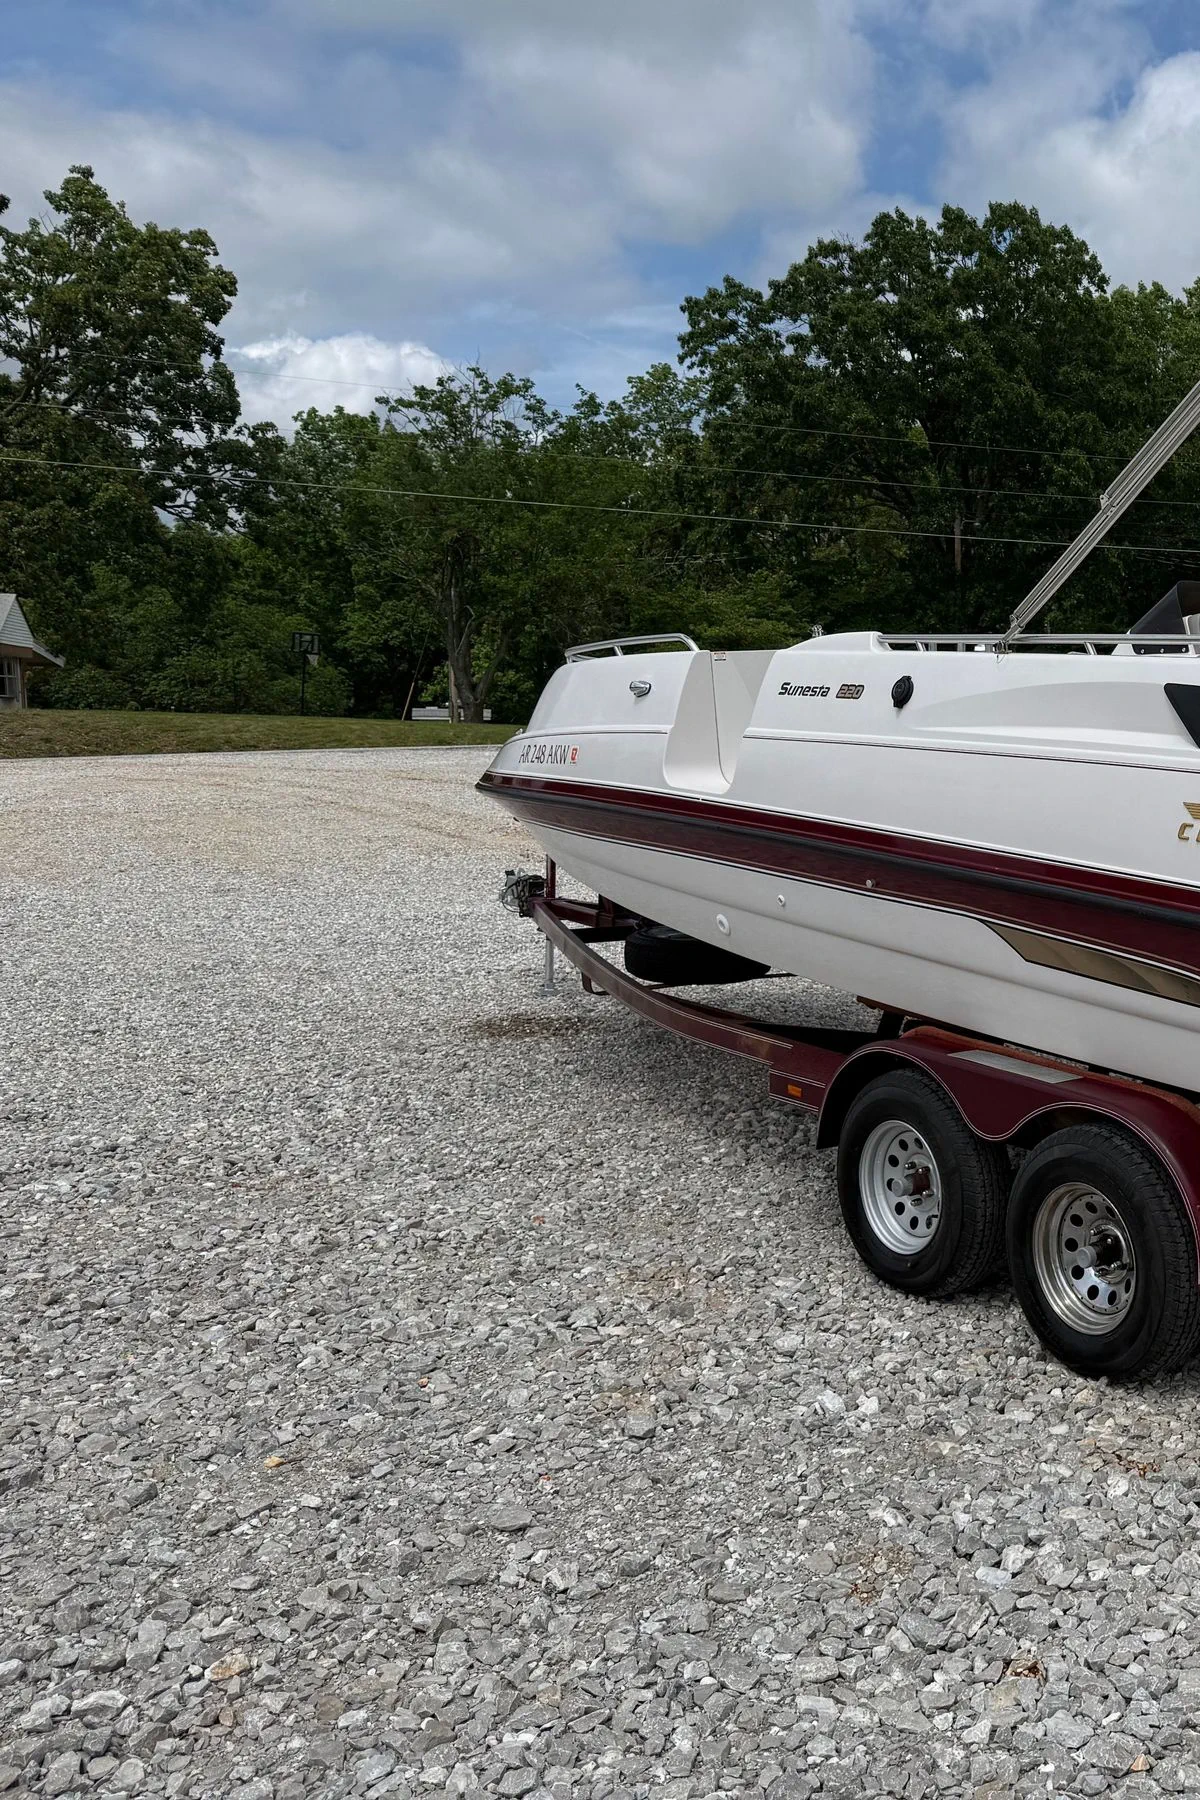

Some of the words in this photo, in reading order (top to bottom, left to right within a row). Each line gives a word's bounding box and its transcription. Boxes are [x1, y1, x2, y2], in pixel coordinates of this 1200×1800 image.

[778, 682, 831, 697] Sunesta
[836, 684, 865, 699] 220
[518, 744, 531, 764] AR
[530, 744, 547, 764] 248
[546, 745, 570, 765] AKW
